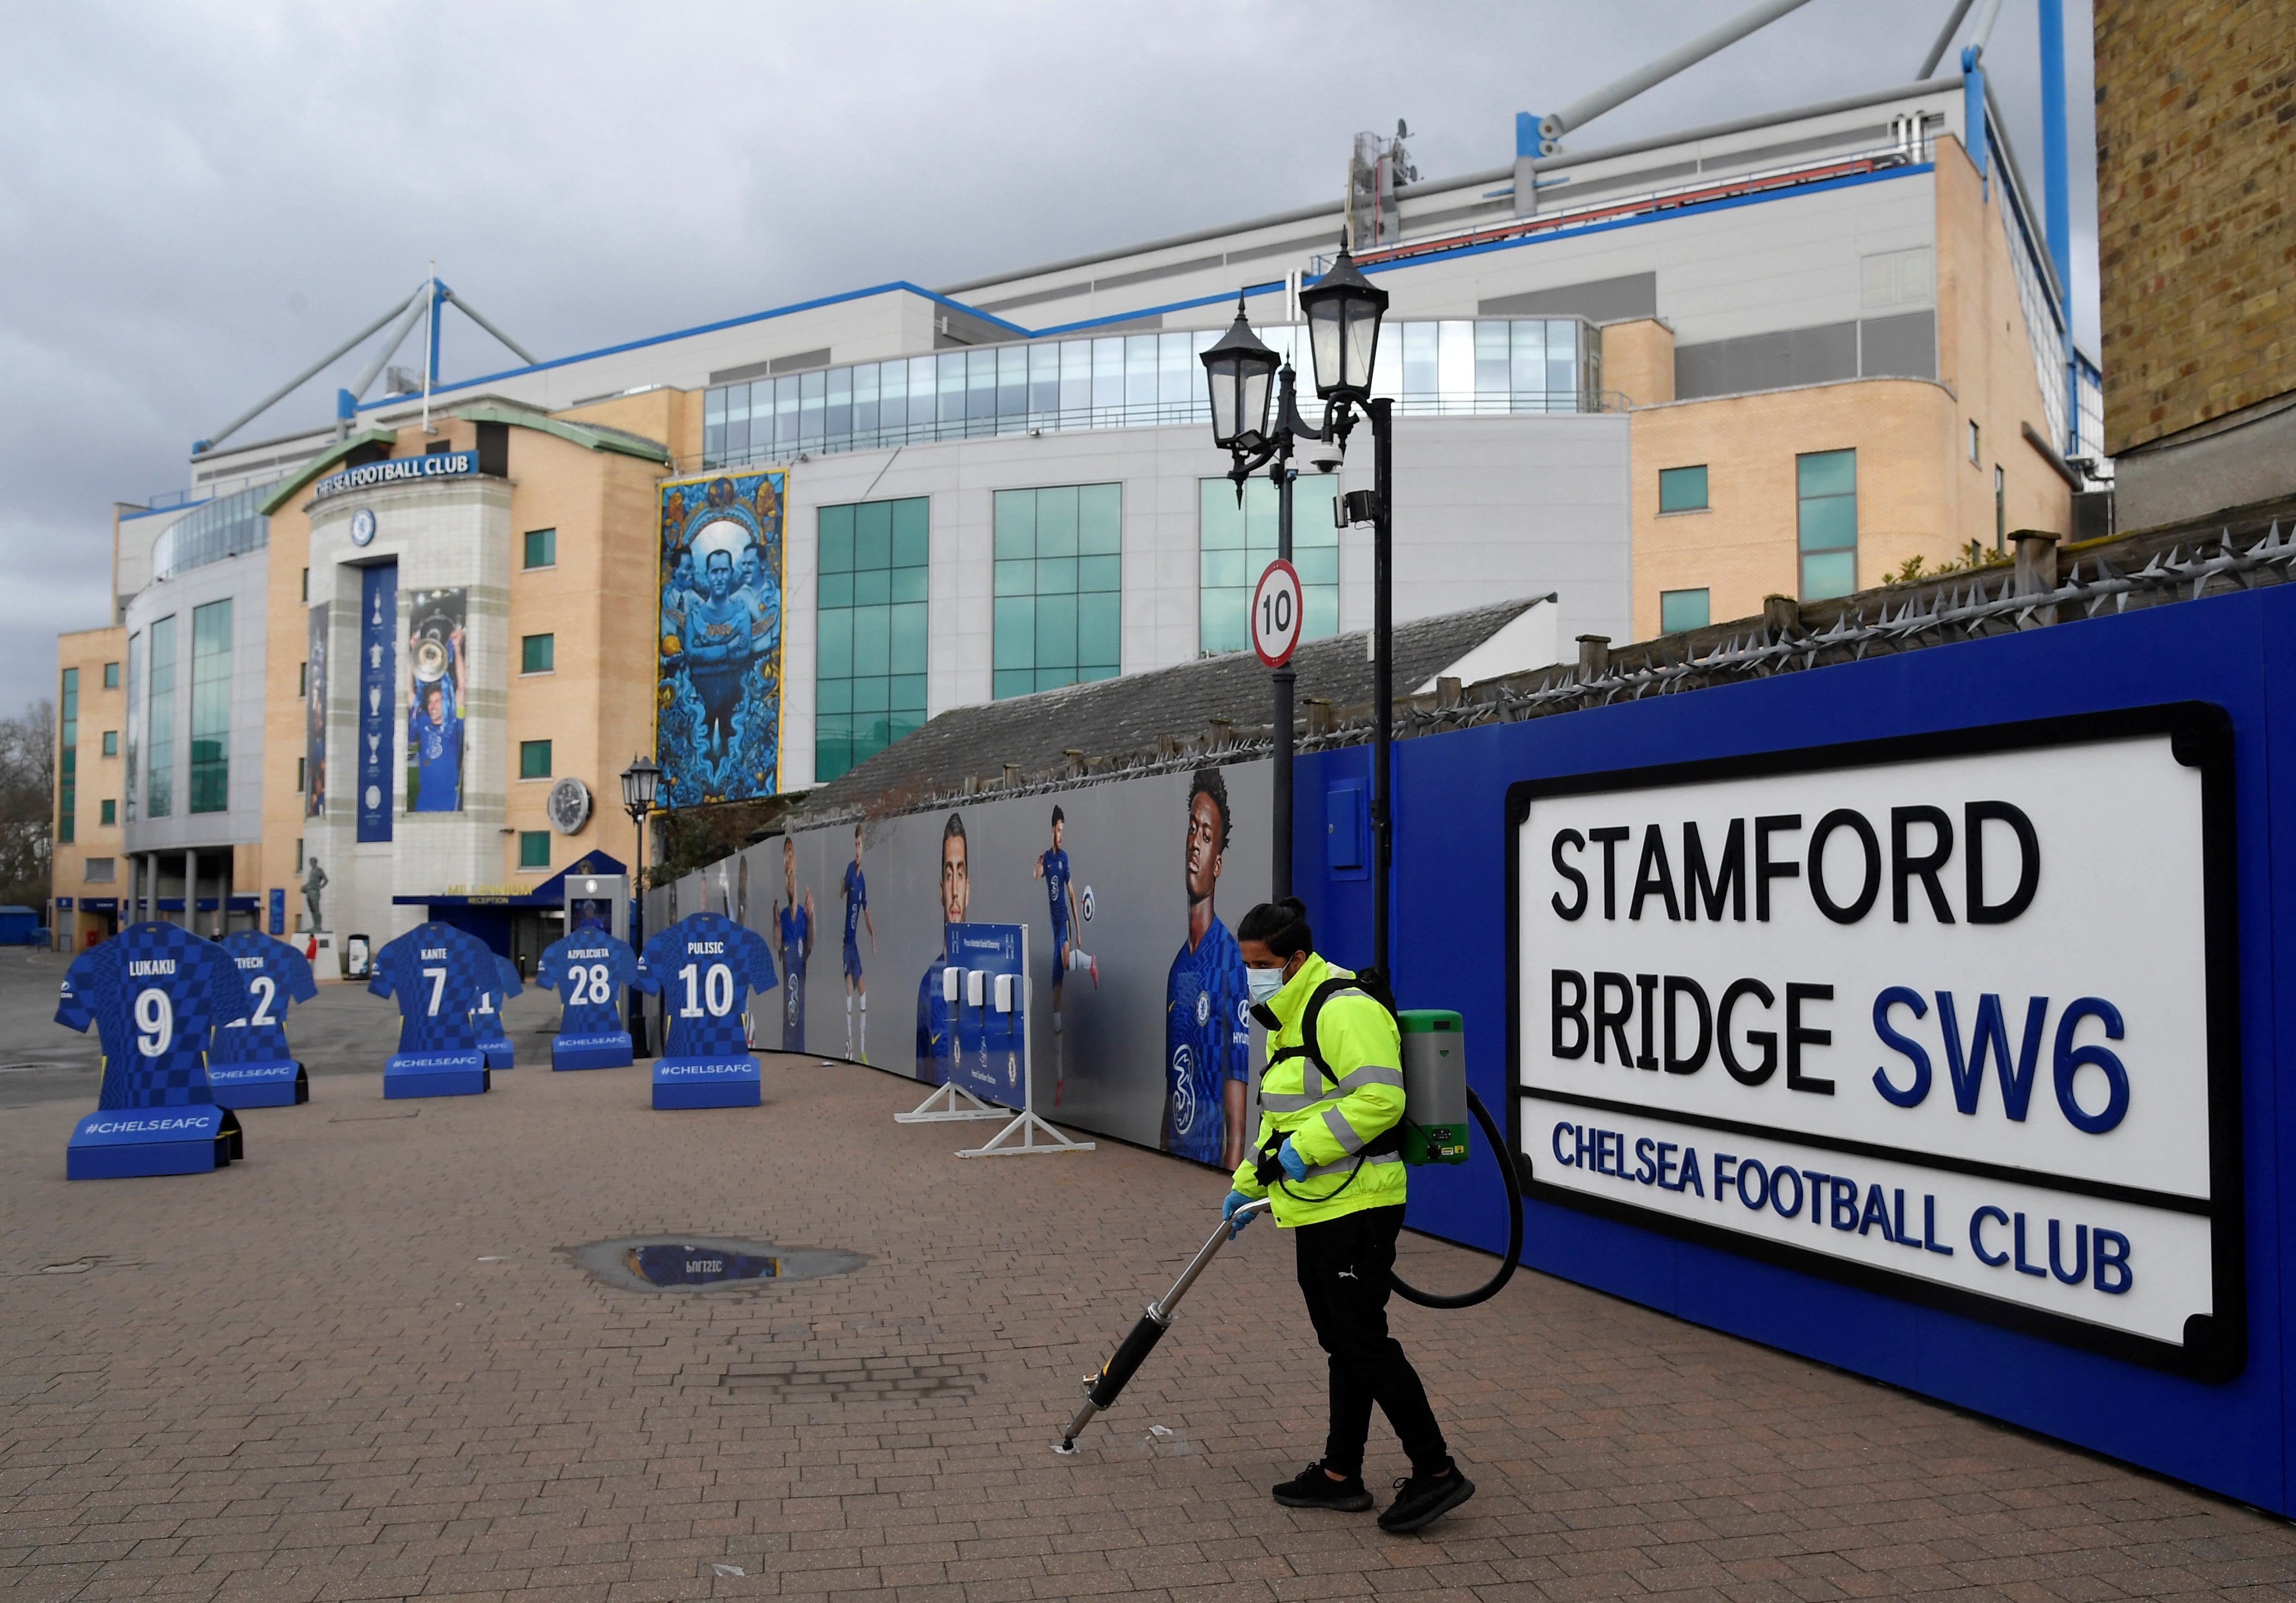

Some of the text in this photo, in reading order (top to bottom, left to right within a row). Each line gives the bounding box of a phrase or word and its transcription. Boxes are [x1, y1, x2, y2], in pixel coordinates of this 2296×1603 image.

[315, 455, 469, 498] CHELSEA FOOTBALL CLUB
[1263, 589, 1291, 635] 10
[1551, 800, 2041, 924] STAMFORD
[447, 884, 533, 896] MILLENNIUM
[467, 896, 510, 905] RECEPTION
[420, 948, 447, 961] KANTE
[567, 948, 609, 960] AZPILICUETA
[687, 941, 724, 955] PULISIC
[129, 959, 176, 977] LUKAKU
[422, 967, 447, 1017] 7
[568, 963, 611, 1006] 28
[678, 963, 734, 1018] 10
[222, 976, 277, 1028] 2
[134, 987, 173, 1058] 9
[558, 1036, 626, 1047] #CHELSEAFC
[1551, 969, 2130, 1134] BRIDGE SW6
[392, 1056, 477, 1068] #CHELSEAFC
[661, 1064, 752, 1076] #CHELSEAFC
[209, 1067, 290, 1080] CHELSEAFC
[85, 1117, 210, 1135] #CHELSEAFC
[1552, 1121, 2133, 1295] CHELSEA FOOTBALL CLUB
